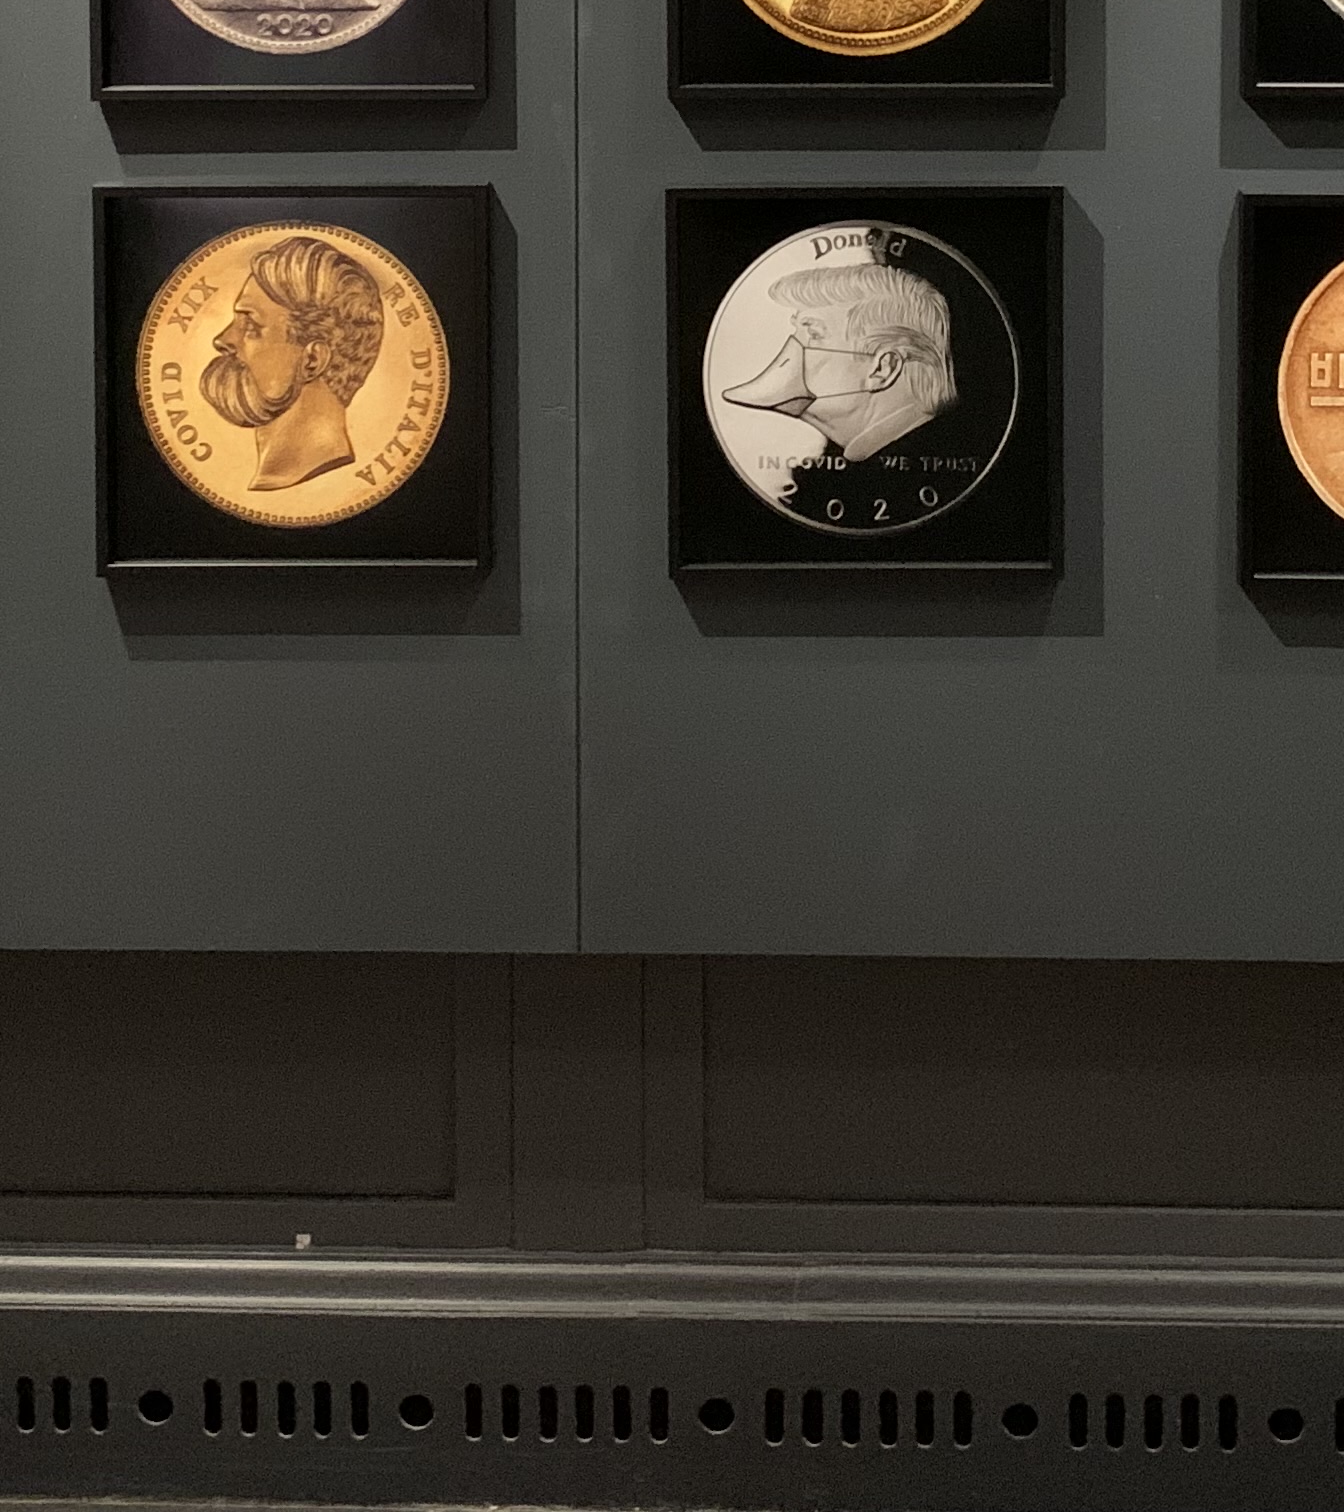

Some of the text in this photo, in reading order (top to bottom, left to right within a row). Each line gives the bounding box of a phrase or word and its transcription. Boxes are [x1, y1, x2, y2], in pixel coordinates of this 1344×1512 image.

[256, 13, 335, 37] 2020
[161, 275, 220, 463] COVID XIX
[355, 282, 434, 487] RE D'ITALIA
[758, 455, 780, 470] IN
[786, 455, 847, 471] COVID
[879, 455, 910, 471] WE
